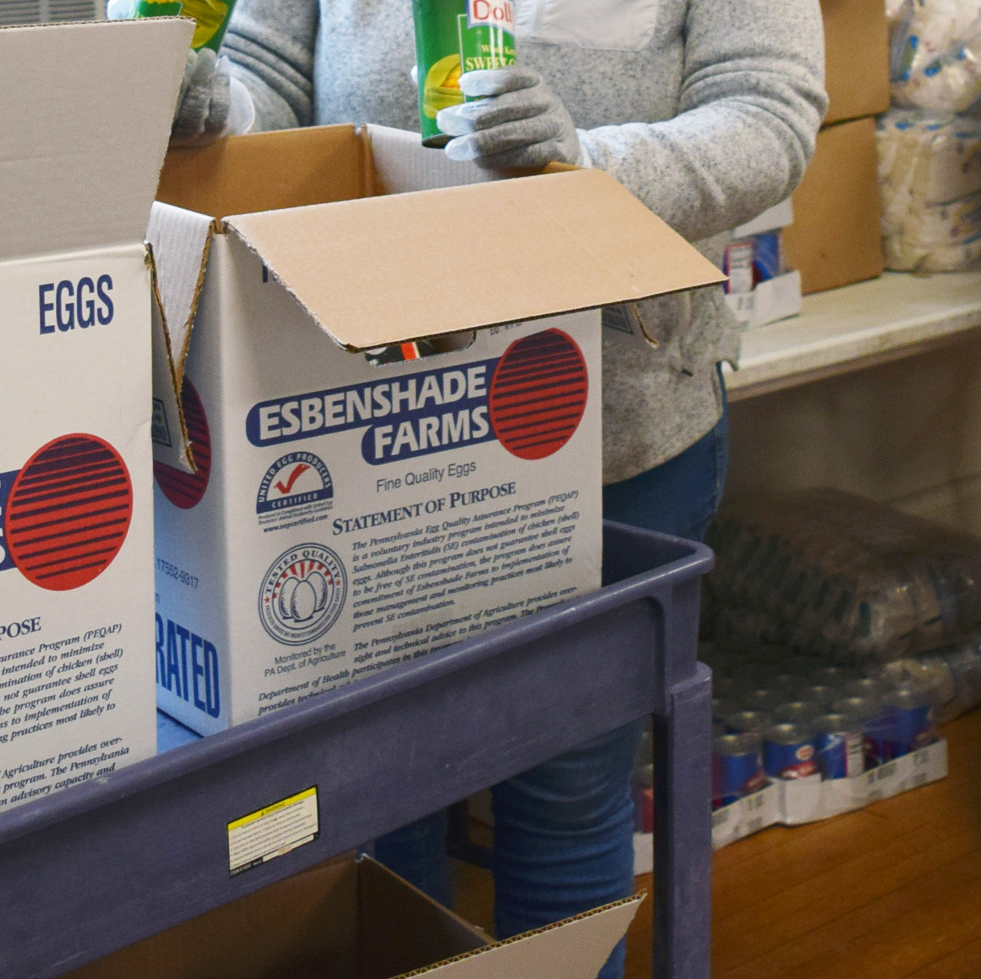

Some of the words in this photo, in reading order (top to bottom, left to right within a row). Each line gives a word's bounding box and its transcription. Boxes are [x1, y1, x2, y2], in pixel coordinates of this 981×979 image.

[38, 274, 115, 335] EGGS
[258, 366, 487, 441] ESBENSHADE
[374, 406, 490, 459] FARMS
[258, 468, 276, 502] UNITED
[277, 454, 293, 467] EGG
[296, 453, 333, 488] PRODUCERS
[376, 478, 402, 493] Fine
[405, 467, 444, 486] Quality
[448, 461, 476, 480] Eggs
[272, 493, 318, 508] CERTIFIED
[332, 502, 423, 536] STATEMENT
[425, 498, 446, 514] OF
[449, 482, 516, 509] PURPOSE
[266, 553, 298, 594] TESTED
[302, 550, 341, 578] QUALITY
[38, 635, 80, 653] Program
[83, 623, 122, 642] (PEQAP)
[274, 648, 312, 665] Monitored
[313, 646, 323, 656] by
[324, 643, 336, 652] the
[1, 655, 46, 676] intended
[47, 655, 58, 663] to
[60, 642, 105, 660] minimize
[45, 665, 56, 679] of
[56, 658, 93, 674] chicken
[95, 648, 124, 665] (shell)
[155, 613, 221, 719] RATED
[264, 668, 276, 677] PA
[299, 659, 307, 668] of
[307, 650, 346, 667] Agriculture
[3, 690, 20, 702] not
[21, 676, 72, 699] guarantee
[74, 667, 97, 682] shell
[98, 663, 119, 676] eggs
[12, 694, 56, 715] program
[59, 687, 82, 699] does
[83, 677, 115, 692] assure
[11, 717, 21, 726] to
[24, 695, 99, 722] implementation
[101, 688, 112, 701] of
